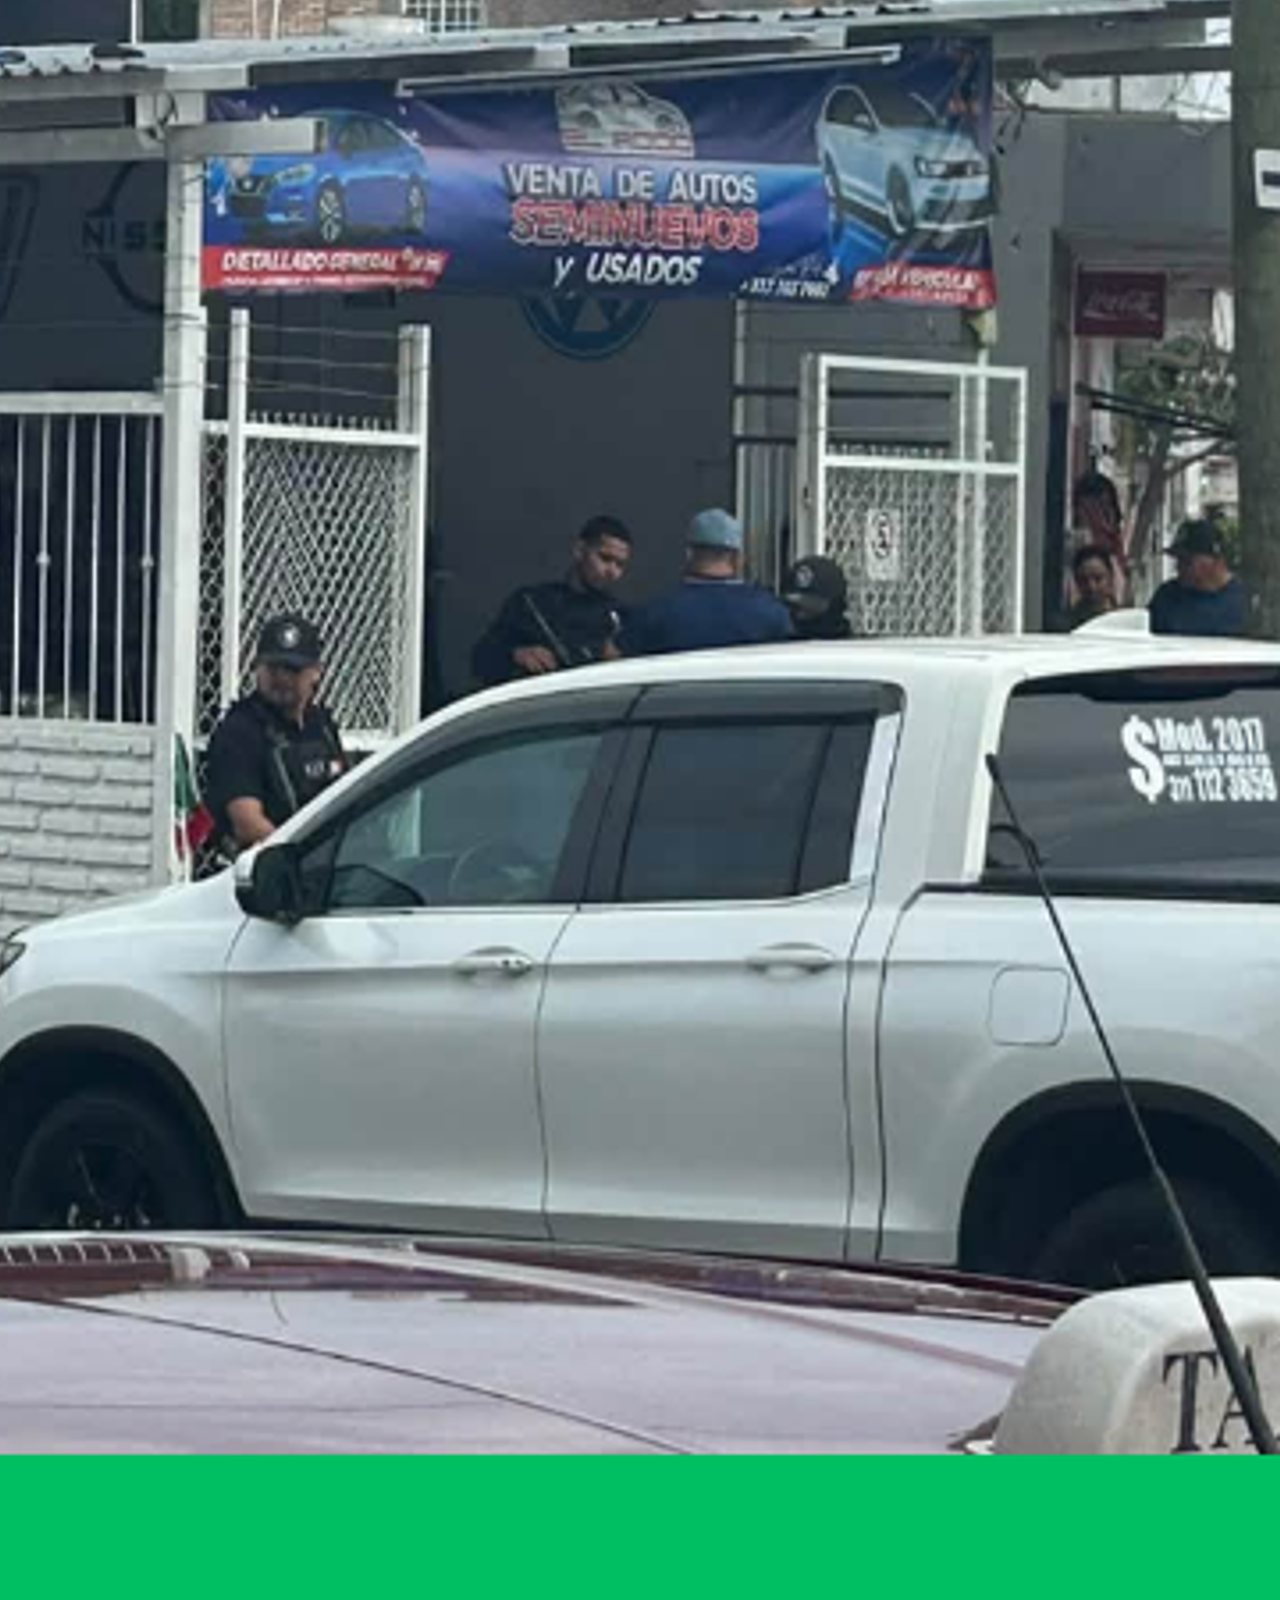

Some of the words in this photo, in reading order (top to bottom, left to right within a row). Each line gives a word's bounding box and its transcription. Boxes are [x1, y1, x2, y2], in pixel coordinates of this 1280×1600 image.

[508, 163, 602, 197] VENTA
[617, 169, 653, 199] DE
[669, 173, 758, 204] AUTOS
[508, 196, 760, 252] SEMINUEVOS
[221, 249, 326, 272] DETALLADO
[585, 252, 703, 285] USADOS
[1121, 714, 1165, 804] $
[1153, 716, 1214, 752] Mod.
[1212, 716, 1265, 752] 2017
